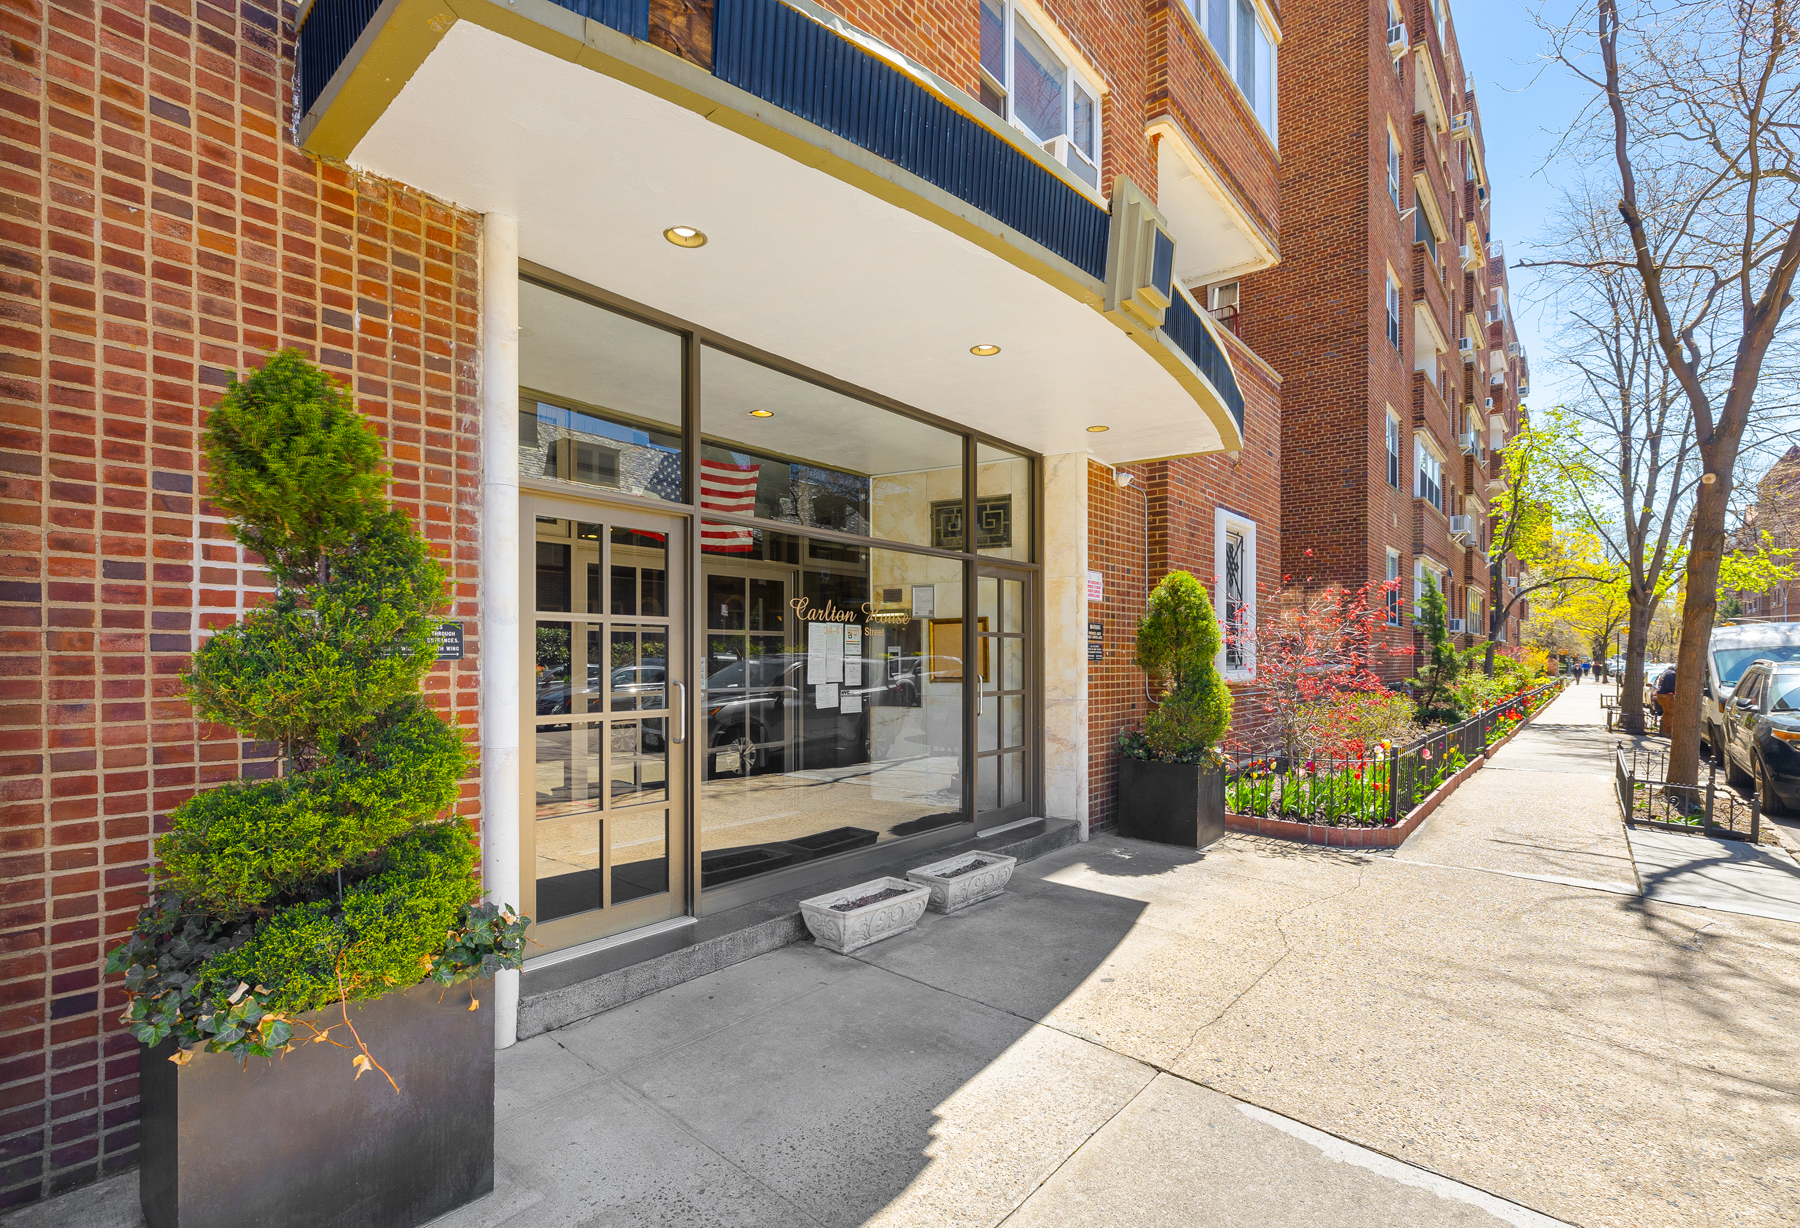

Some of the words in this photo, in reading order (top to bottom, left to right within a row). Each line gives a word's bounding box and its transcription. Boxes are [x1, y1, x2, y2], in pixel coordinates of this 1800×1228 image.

[790, 597, 857, 622] Carlton
[861, 602, 911, 624] House
[864, 626, 885, 636] Street
